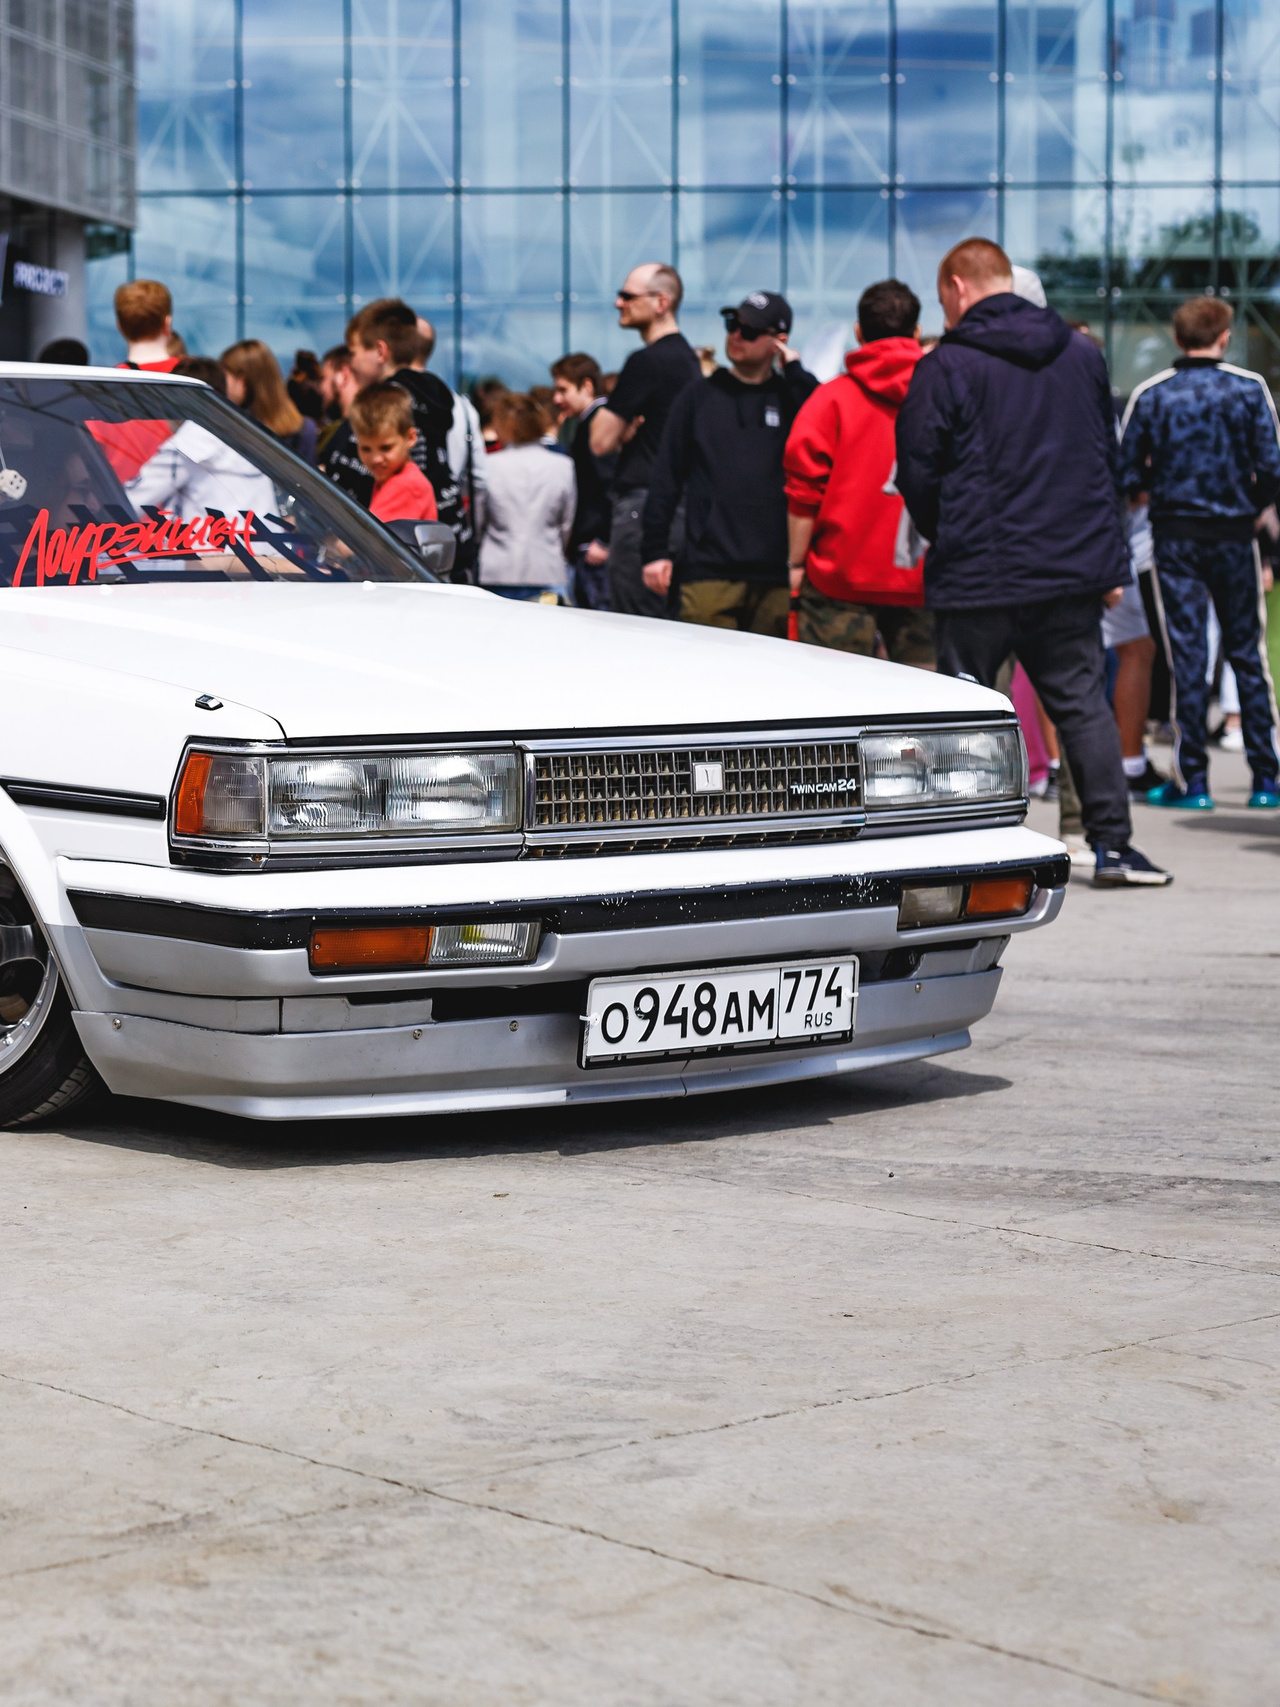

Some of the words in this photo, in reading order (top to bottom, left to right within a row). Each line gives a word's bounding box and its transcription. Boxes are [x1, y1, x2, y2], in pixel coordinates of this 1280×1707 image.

[790, 783, 815, 795] TWIN
[815, 782, 837, 793] CAM
[837, 778, 856, 791] 24
[783, 966, 842, 1013] 774
[804, 1011, 833, 1029] RUS
